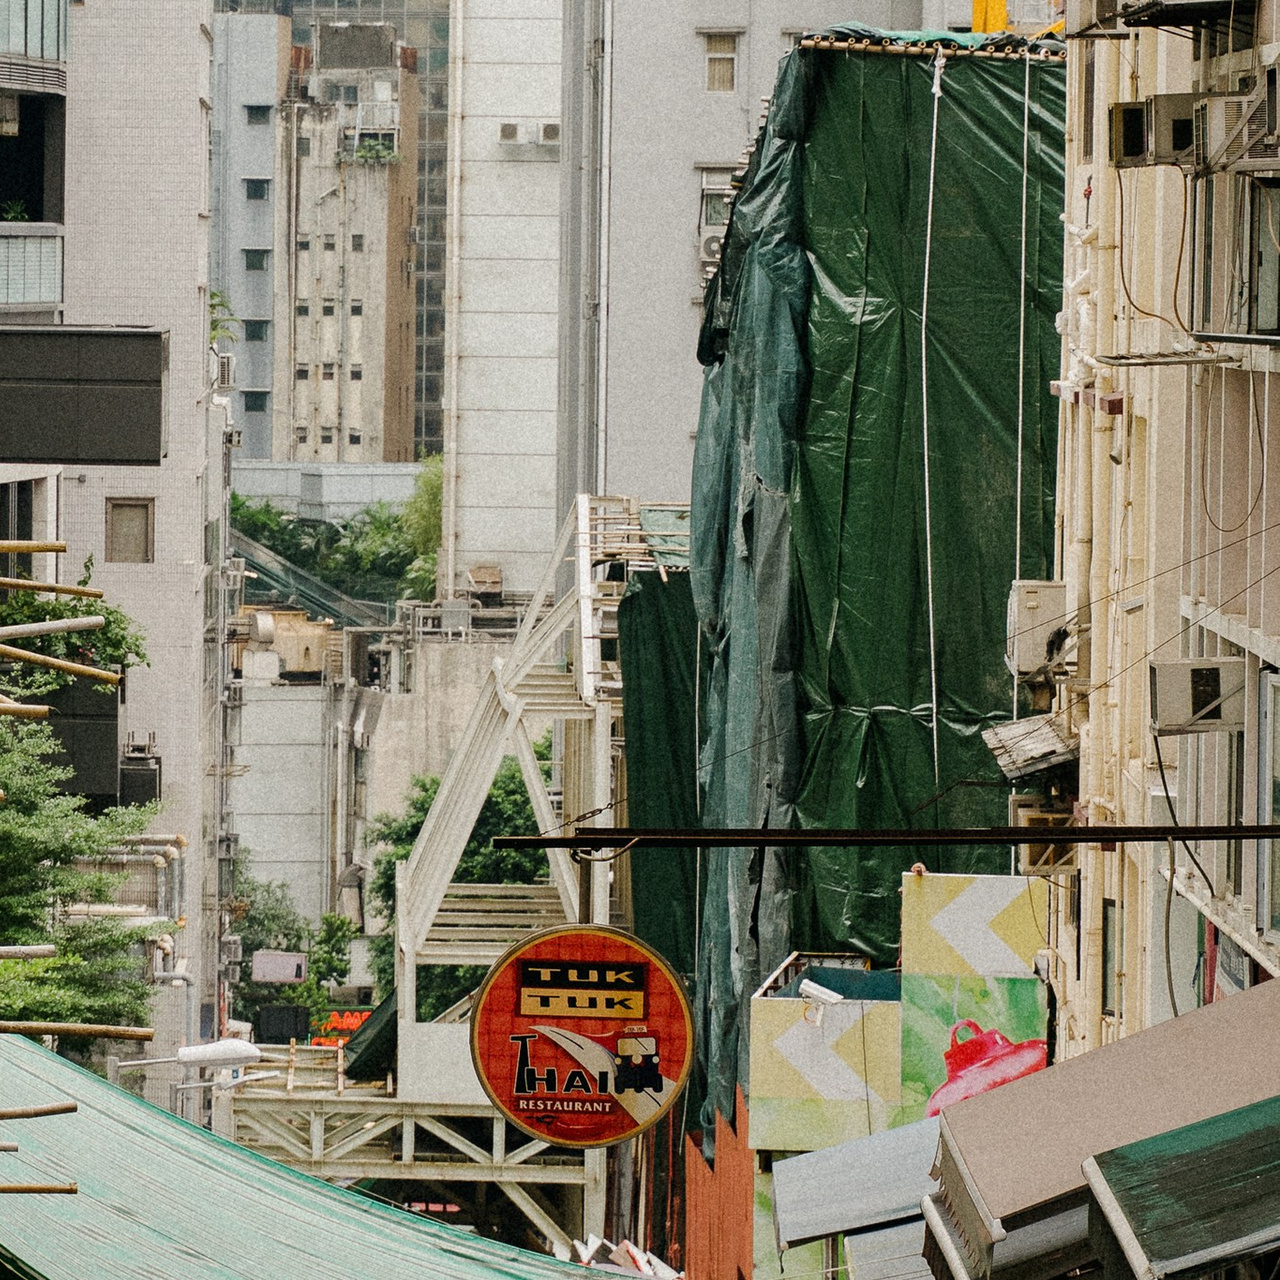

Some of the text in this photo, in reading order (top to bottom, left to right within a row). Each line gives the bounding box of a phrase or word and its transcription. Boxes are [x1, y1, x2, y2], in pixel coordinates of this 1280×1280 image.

[528, 968, 635, 983] TUK
[527, 995, 634, 1010] TUK
[510, 1034, 610, 1094] THAI
[519, 1099, 612, 1113] RESTAURANT
